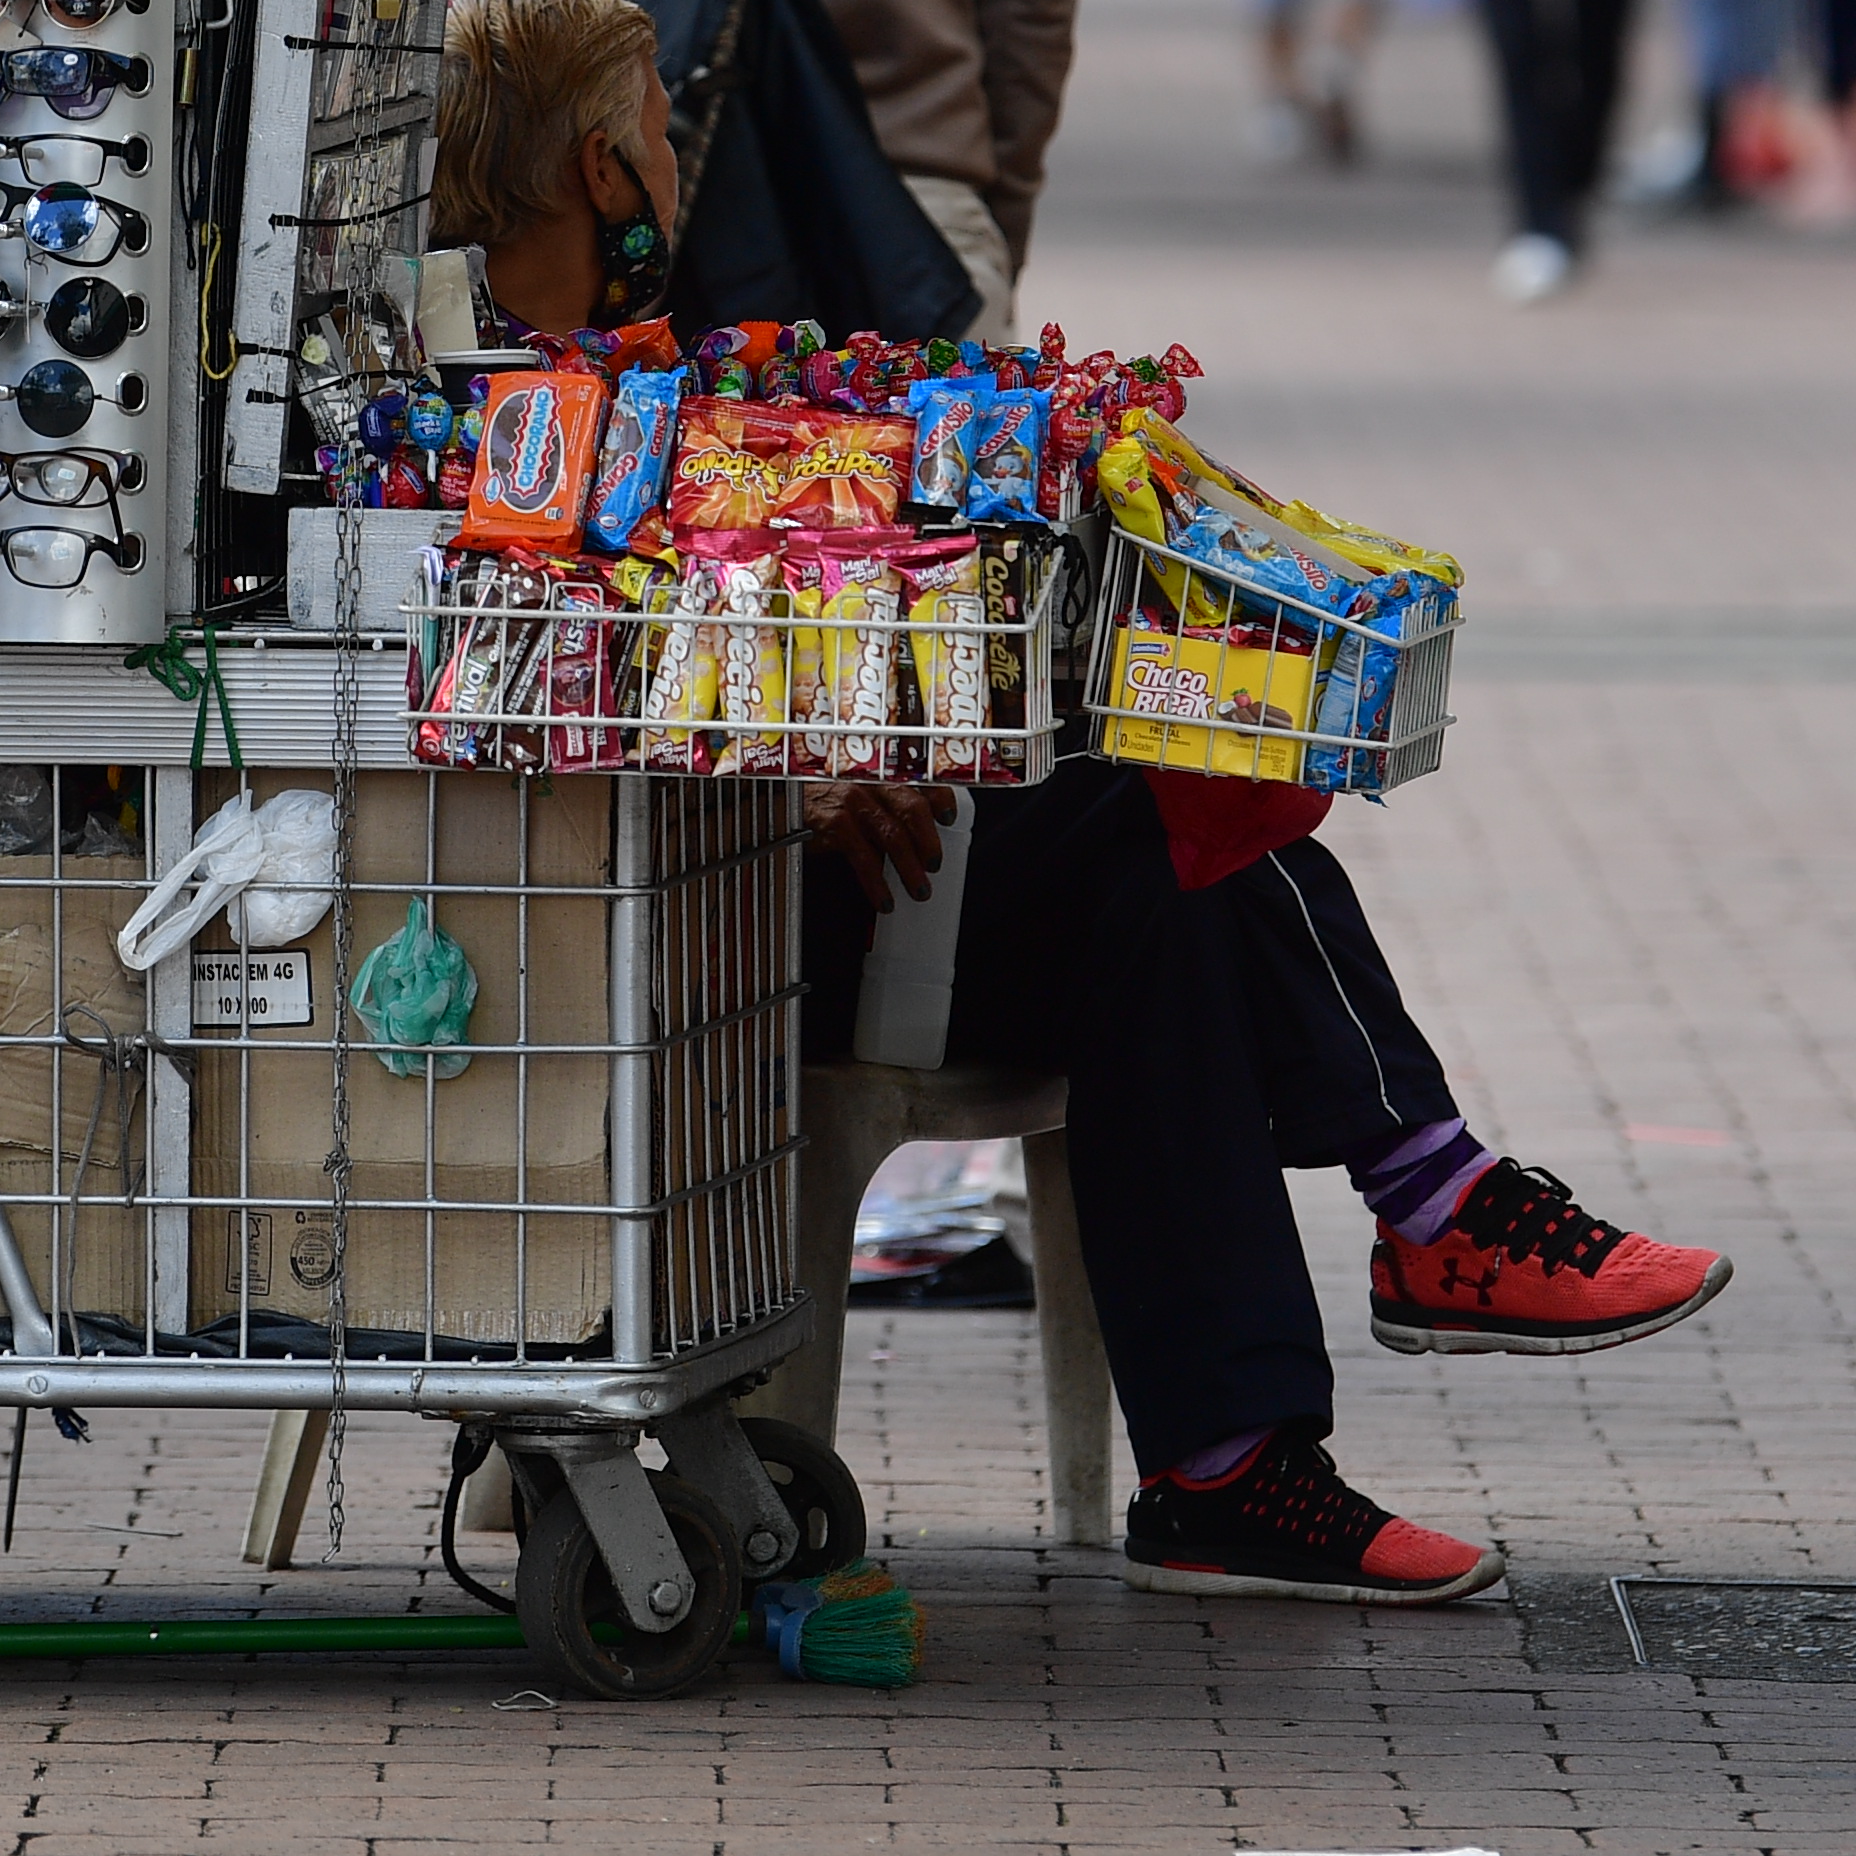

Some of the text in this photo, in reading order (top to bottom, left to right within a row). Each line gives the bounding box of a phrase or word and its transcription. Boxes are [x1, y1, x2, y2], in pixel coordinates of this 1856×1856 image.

[517, 391, 549, 487] CHOCORAMO
[920, 400, 974, 458] GANSITO
[976, 403, 1032, 459] GANSITO
[584, 452, 639, 522] GANSIT
[855, 563, 881, 584] Sal
[932, 562, 959, 590] Sal
[1290, 546, 1328, 591] NSITO
[984, 556, 1011, 692] Cocosette
[1127, 659, 1208, 694] Choco
[442, 656, 490, 755] Fetival
[1134, 691, 1215, 720] Break
[193, 962, 294, 981] INSTACEM 4G
[218, 996, 232, 1015] 10
